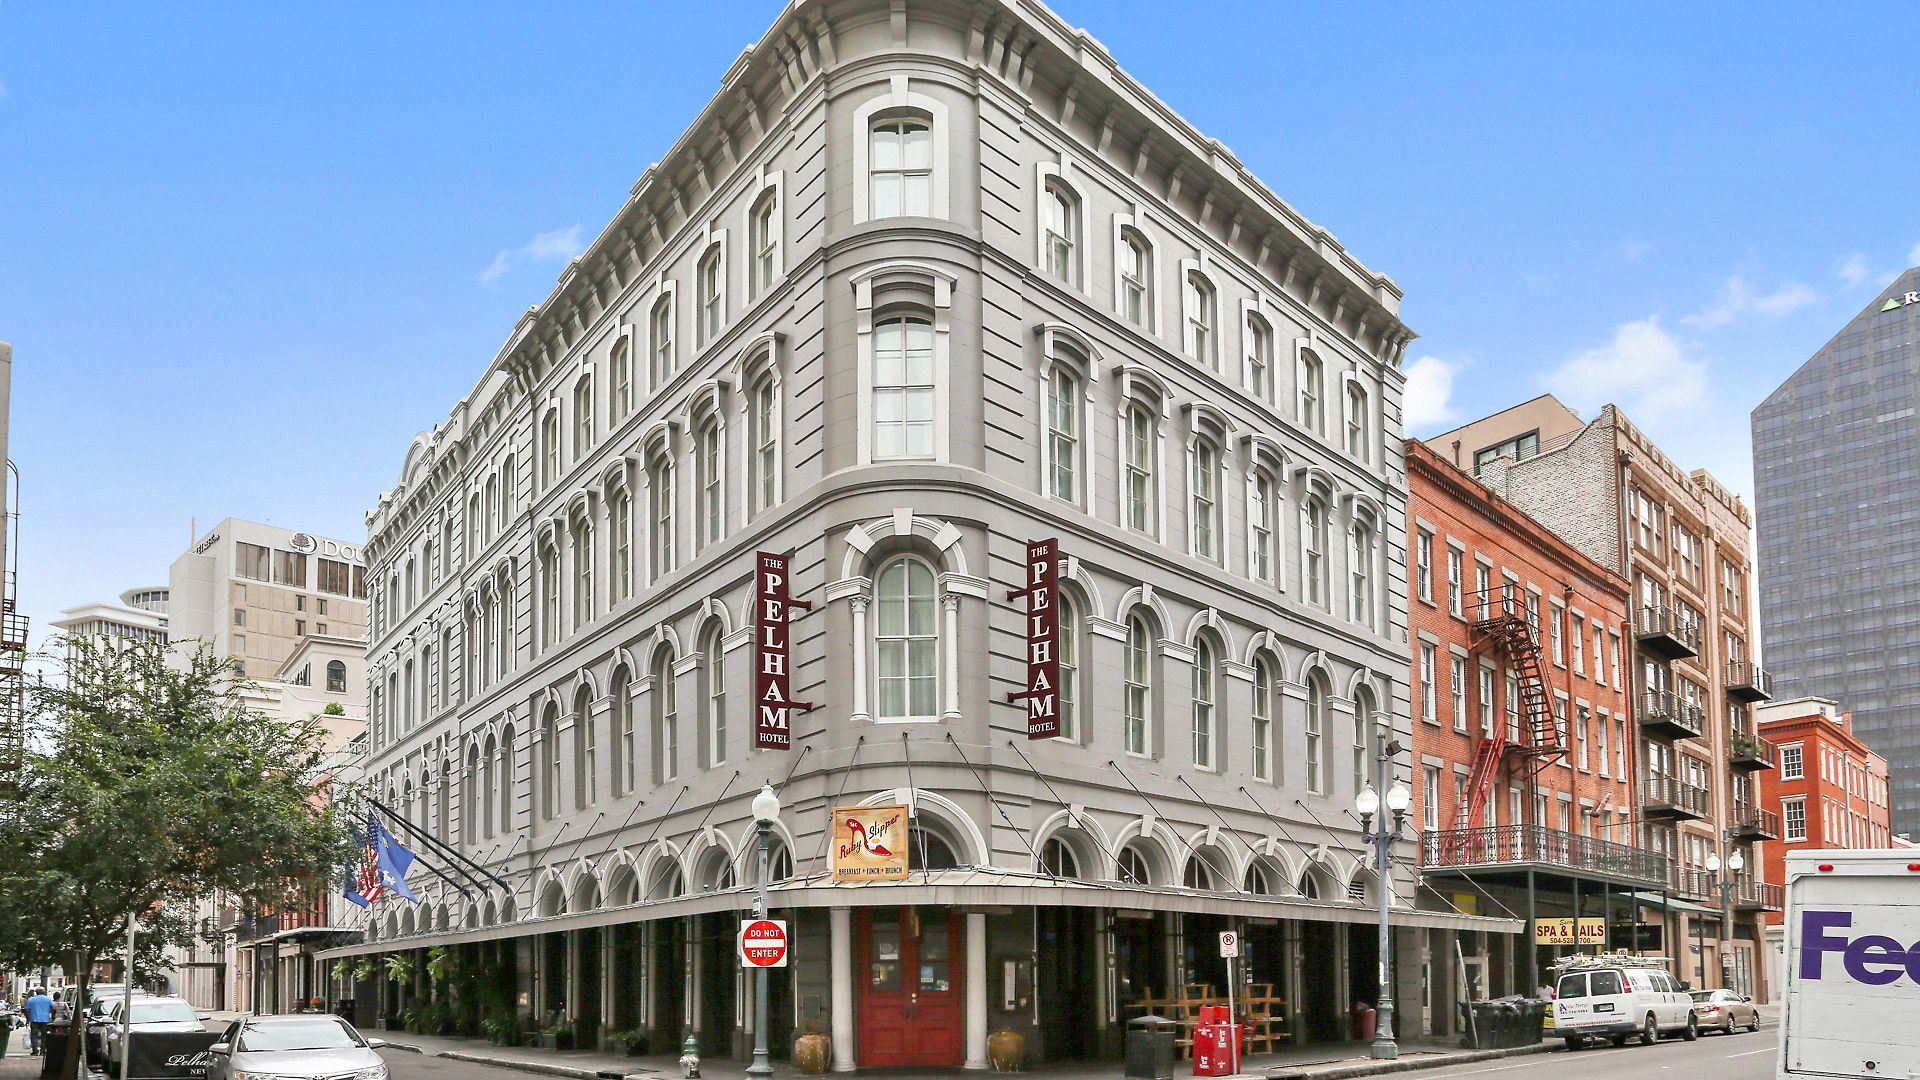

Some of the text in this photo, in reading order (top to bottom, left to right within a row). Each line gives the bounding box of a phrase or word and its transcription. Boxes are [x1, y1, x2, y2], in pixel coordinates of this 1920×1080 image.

[1903, 291, 1920, 306] R
[322, 539, 365, 563] DOU
[1031, 545, 1049, 558] THE
[764, 558, 783, 569] THE
[1029, 561, 1055, 719] PELHAM
[760, 572, 788, 729] PELHAM
[1029, 721, 1056, 734] HOTEL
[760, 732, 789, 744] HOTEL
[868, 814, 900, 840] Slipper
[839, 840, 862, 859] Ruby
[838, 866, 903, 876] BREAKFAST LUNCH BRUNCH
[750, 929, 779, 937] DO NOT
[1536, 925, 1557, 937] SPA
[1560, 925, 1568, 937] &
[751, 950, 778, 958] ENTER
[1799, 911, 1920, 985] Fe
[164, 1051, 208, 1067] Pelha
